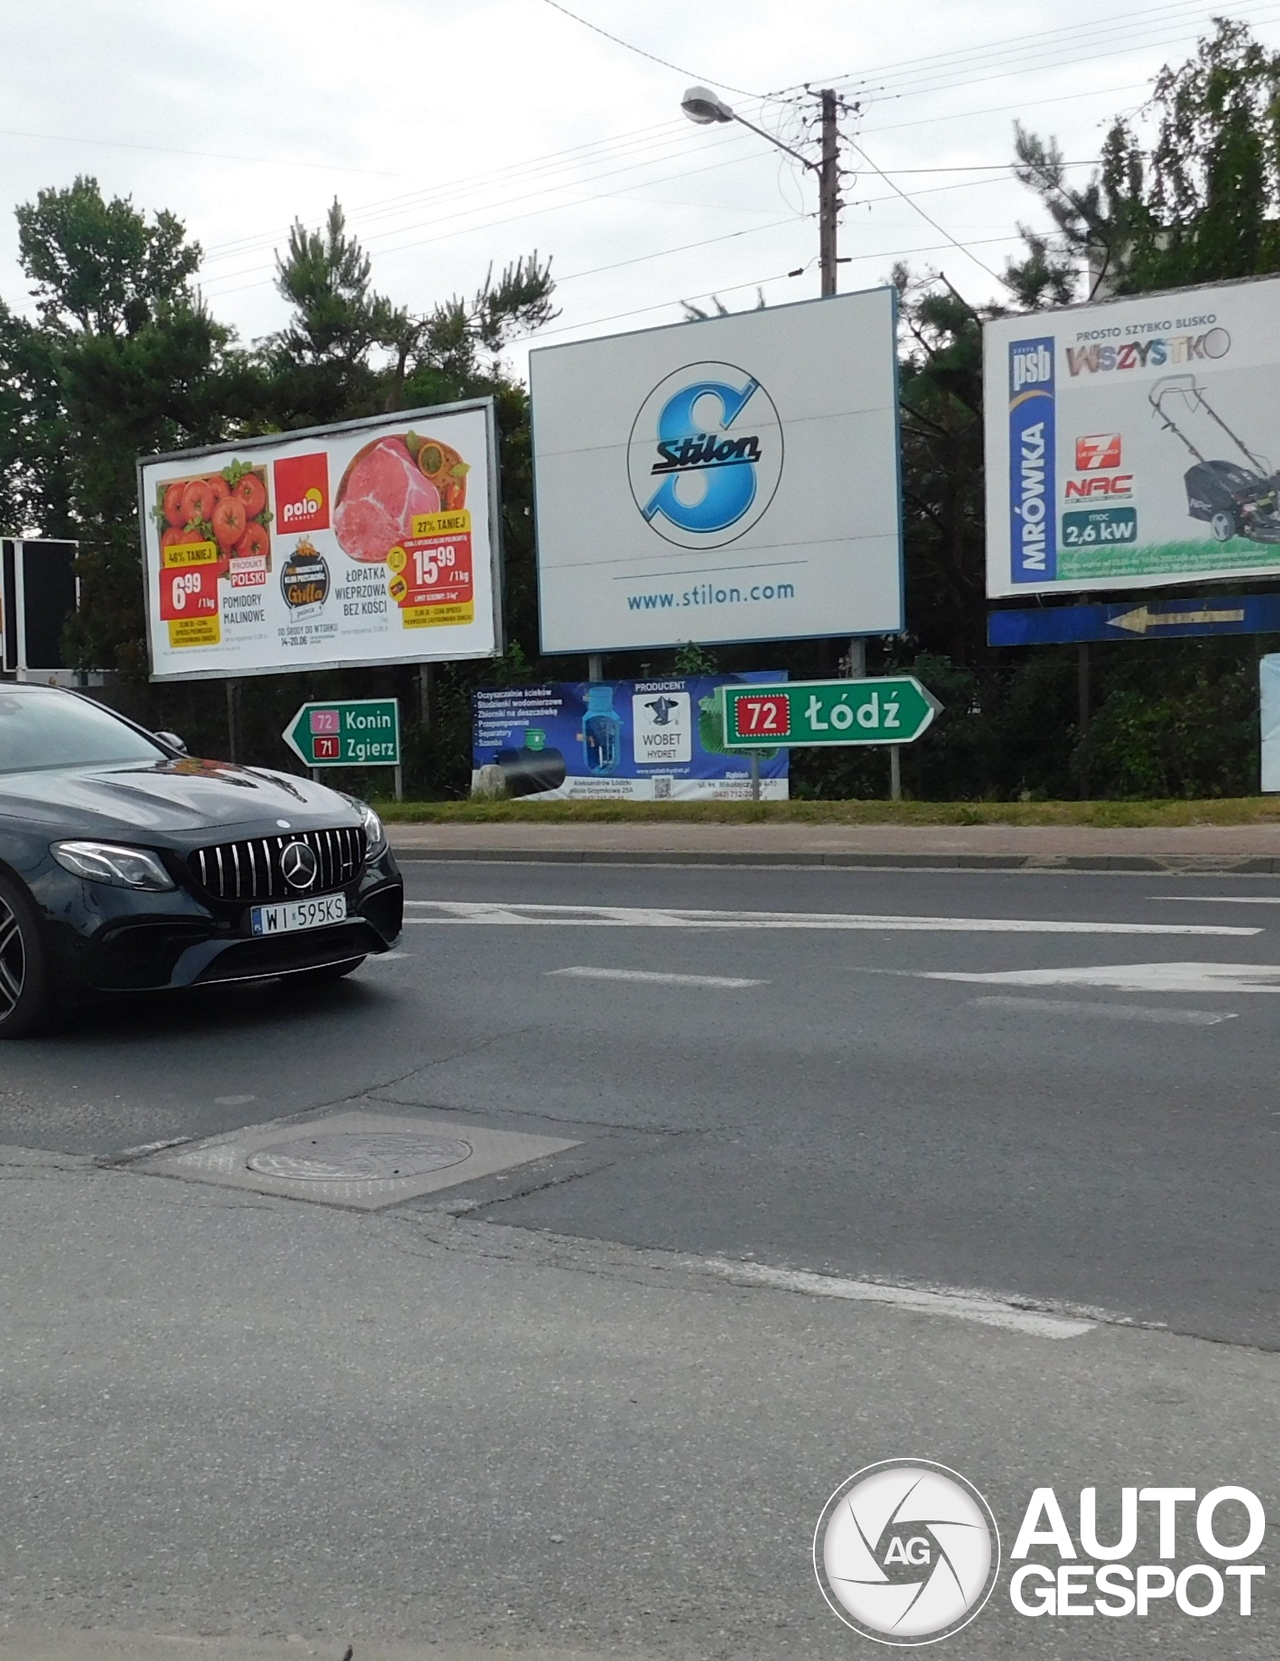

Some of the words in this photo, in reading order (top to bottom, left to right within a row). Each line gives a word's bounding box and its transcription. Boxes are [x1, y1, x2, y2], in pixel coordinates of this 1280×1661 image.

[1076, 327, 1122, 342] PROSTO
[1125, 320, 1172, 336] SZYBKO
[1175, 314, 1217, 328] BLISKO
[1066, 327, 1231, 377] WSZYSTKO
[1013, 345, 1051, 391] psb
[651, 434, 762, 473] Stilon
[1065, 474, 1134, 498] NAC
[1014, 421, 1046, 571] MRÓWKA
[284, 498, 318, 522] polo
[1089, 513, 1110, 521] moc
[417, 521, 436, 533] 27%
[437, 517, 466, 530] TANIEJ
[1066, 525, 1096, 544] 2,6
[1100, 522, 1134, 541] kW
[186, 549, 212, 562] TANIEJ
[232, 559, 263, 570] PRODUKT
[232, 571, 266, 586] POLSKI
[345, 567, 386, 583] ŁOPATKA
[334, 584, 387, 601] WIEPRZOWA
[627, 582, 795, 611] www.stilon.com
[222, 593, 262, 609] POMIDORY
[343, 604, 360, 616] BEZ
[361, 599, 388, 615] KOŚCI
[223, 609, 266, 625] MALINOWE
[305, 625, 314, 634] DO
[314, 623, 339, 633] WTORKU
[635, 681, 686, 692] PRODUCENT
[747, 702, 777, 730] 72
[805, 691, 900, 731] Łódź
[318, 715, 332, 729] 72
[345, 710, 391, 729] Konin
[478, 729, 512, 738] Separatory
[642, 733, 682, 746] WOBET
[320, 740, 332, 755] 71
[347, 739, 394, 761] Zgierz
[478, 738, 503, 746] Szamba
[647, 750, 677, 758] HYDRET
[573, 779, 610, 787] Aleksandrów
[265, 907, 287, 930] WI
[297, 898, 344, 926] 595KS
